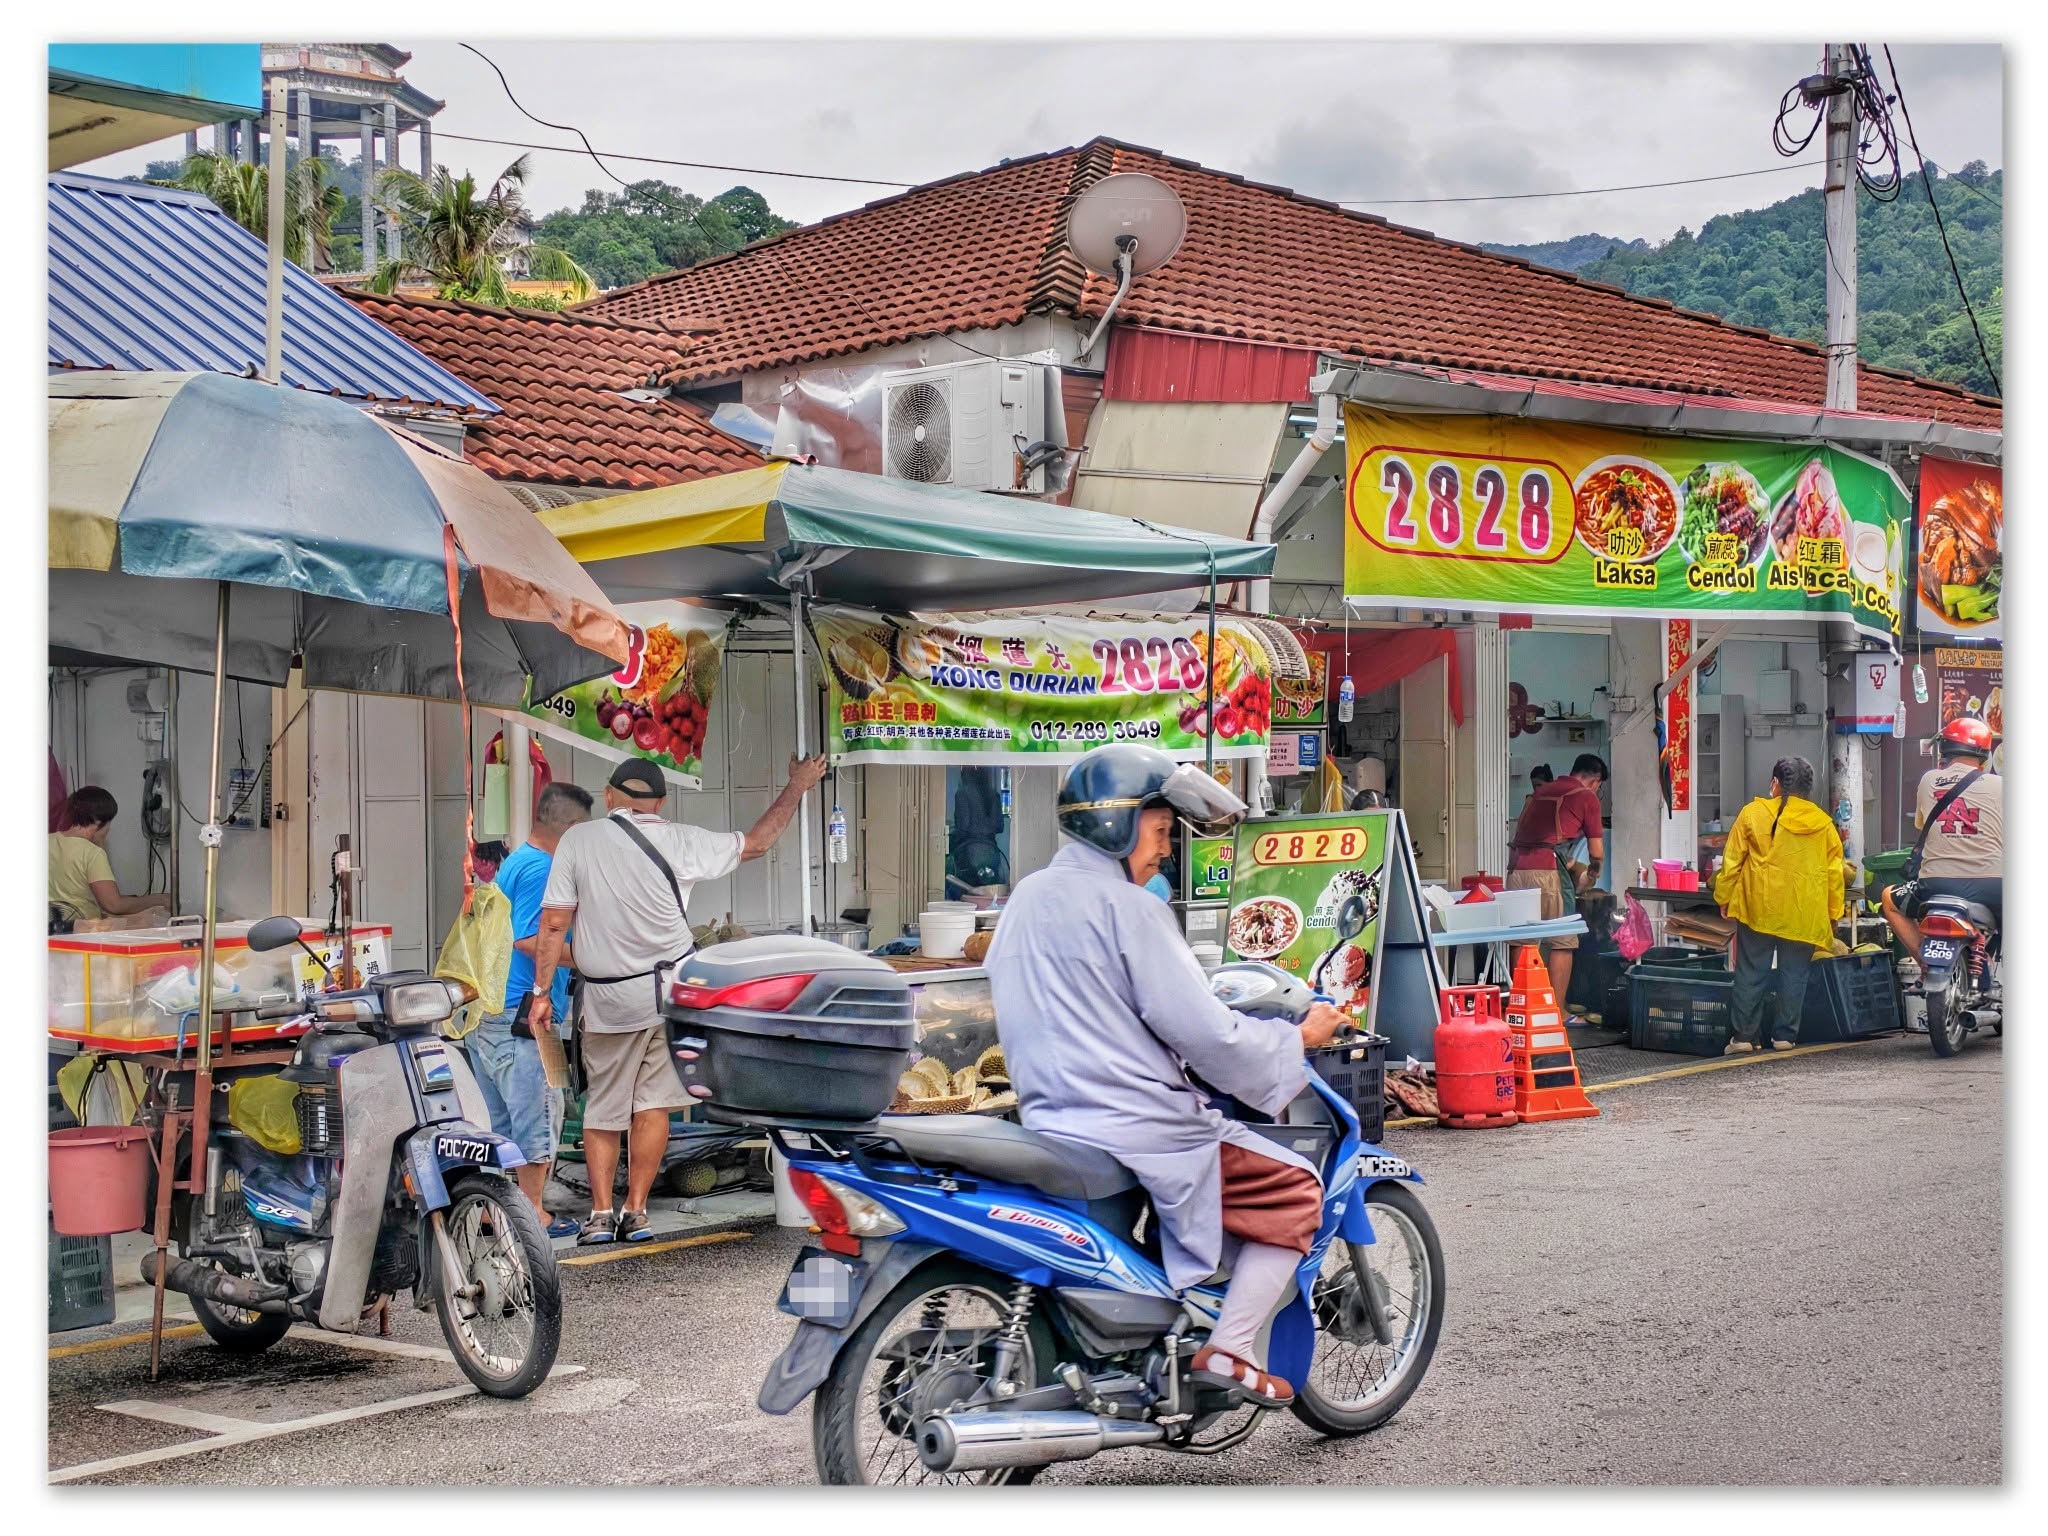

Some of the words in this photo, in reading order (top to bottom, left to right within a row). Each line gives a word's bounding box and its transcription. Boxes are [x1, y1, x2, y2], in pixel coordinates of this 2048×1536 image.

[1382, 458, 1551, 552] 2828
[1610, 531, 1643, 556] 叻沙
[1596, 560, 1656, 586] Laksa
[1688, 565, 1755, 588] Cendol
[1769, 564, 1798, 586] Ais
[930, 665, 1003, 690] KONG
[1008, 671, 1098, 695] DURIAN
[1092, 636, 1206, 693] 2828
[1275, 696, 1315, 719] 叻沙
[1030, 720, 1108, 740] 012-289
[1112, 720, 1161, 739] 3649
[1264, 833, 1356, 860] 2828
[1306, 916, 1337, 927] Cendo
[1923, 949, 1953, 960] 2609
[1929, 939, 1950, 950] PEL
